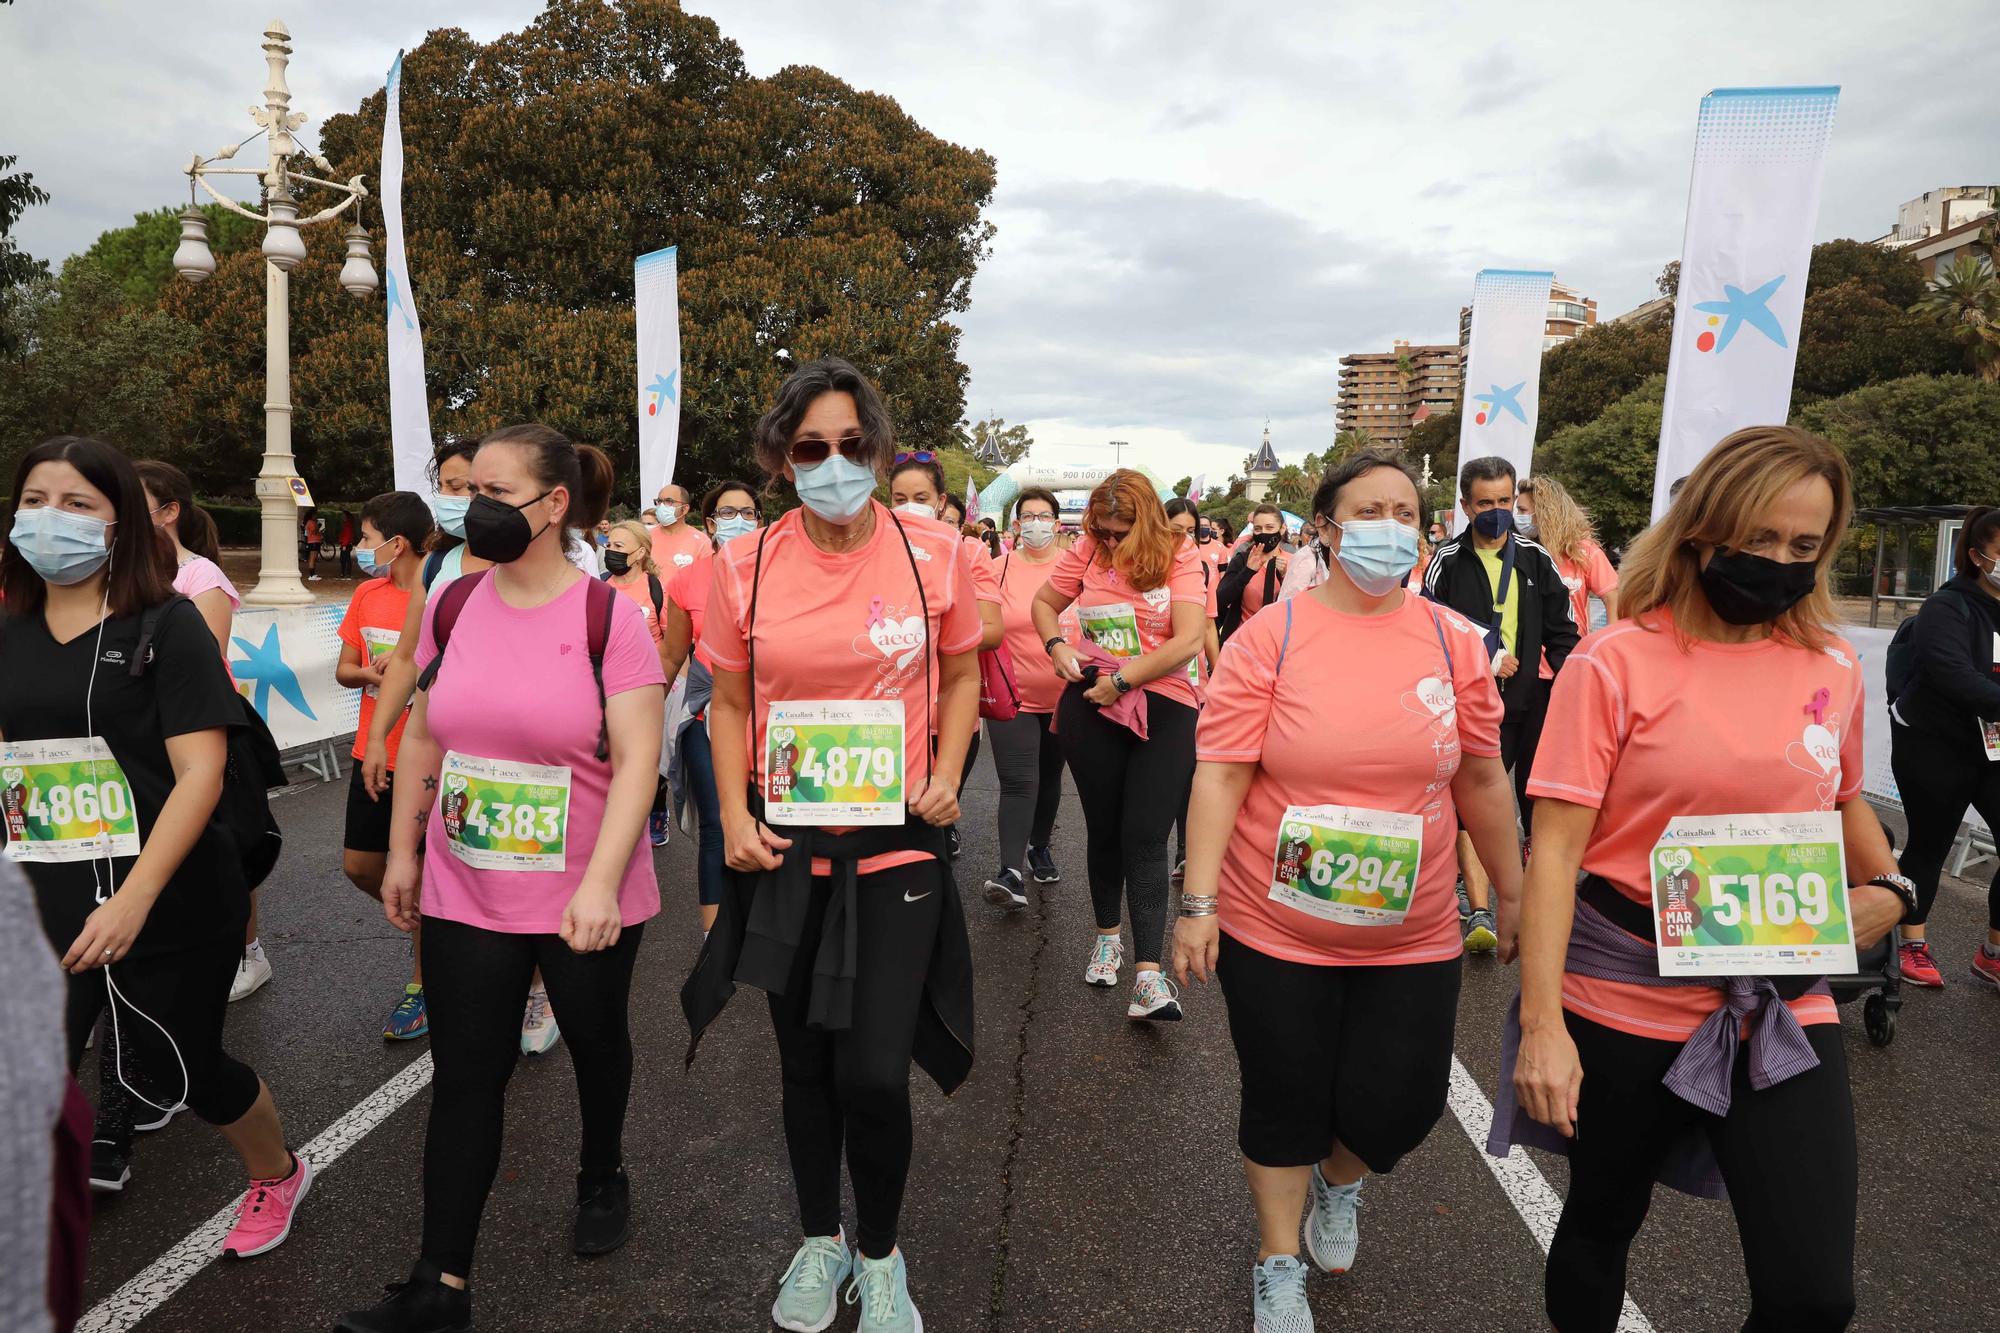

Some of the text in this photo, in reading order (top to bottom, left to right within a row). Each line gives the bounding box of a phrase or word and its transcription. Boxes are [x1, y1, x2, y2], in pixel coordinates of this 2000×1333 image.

[1062, 471, 1079, 479] 900
[1081, 471, 1096, 479] 100
[879, 632, 922, 646] aecc
[830, 711, 853, 719] aecc
[800, 746, 895, 788] 4879
[772, 775, 791, 785] MAR
[772, 785, 791, 796] CHA
[28, 780, 127, 826] 4860
[466, 798, 560, 843] 4383
[1676, 828, 1716, 837] CaixaBank
[1740, 828, 1771, 837] aecc
[1785, 847, 1828, 857] VALENCIA
[1281, 864, 1300, 875] MAR
[1309, 848, 1409, 898] 6294
[1280, 871, 1298, 883] CHA
[1668, 891, 1681, 910] RUN
[1708, 872, 1829, 927] 5169
[1666, 911, 1693, 924] MAR
[1667, 924, 1694, 937] CHA
